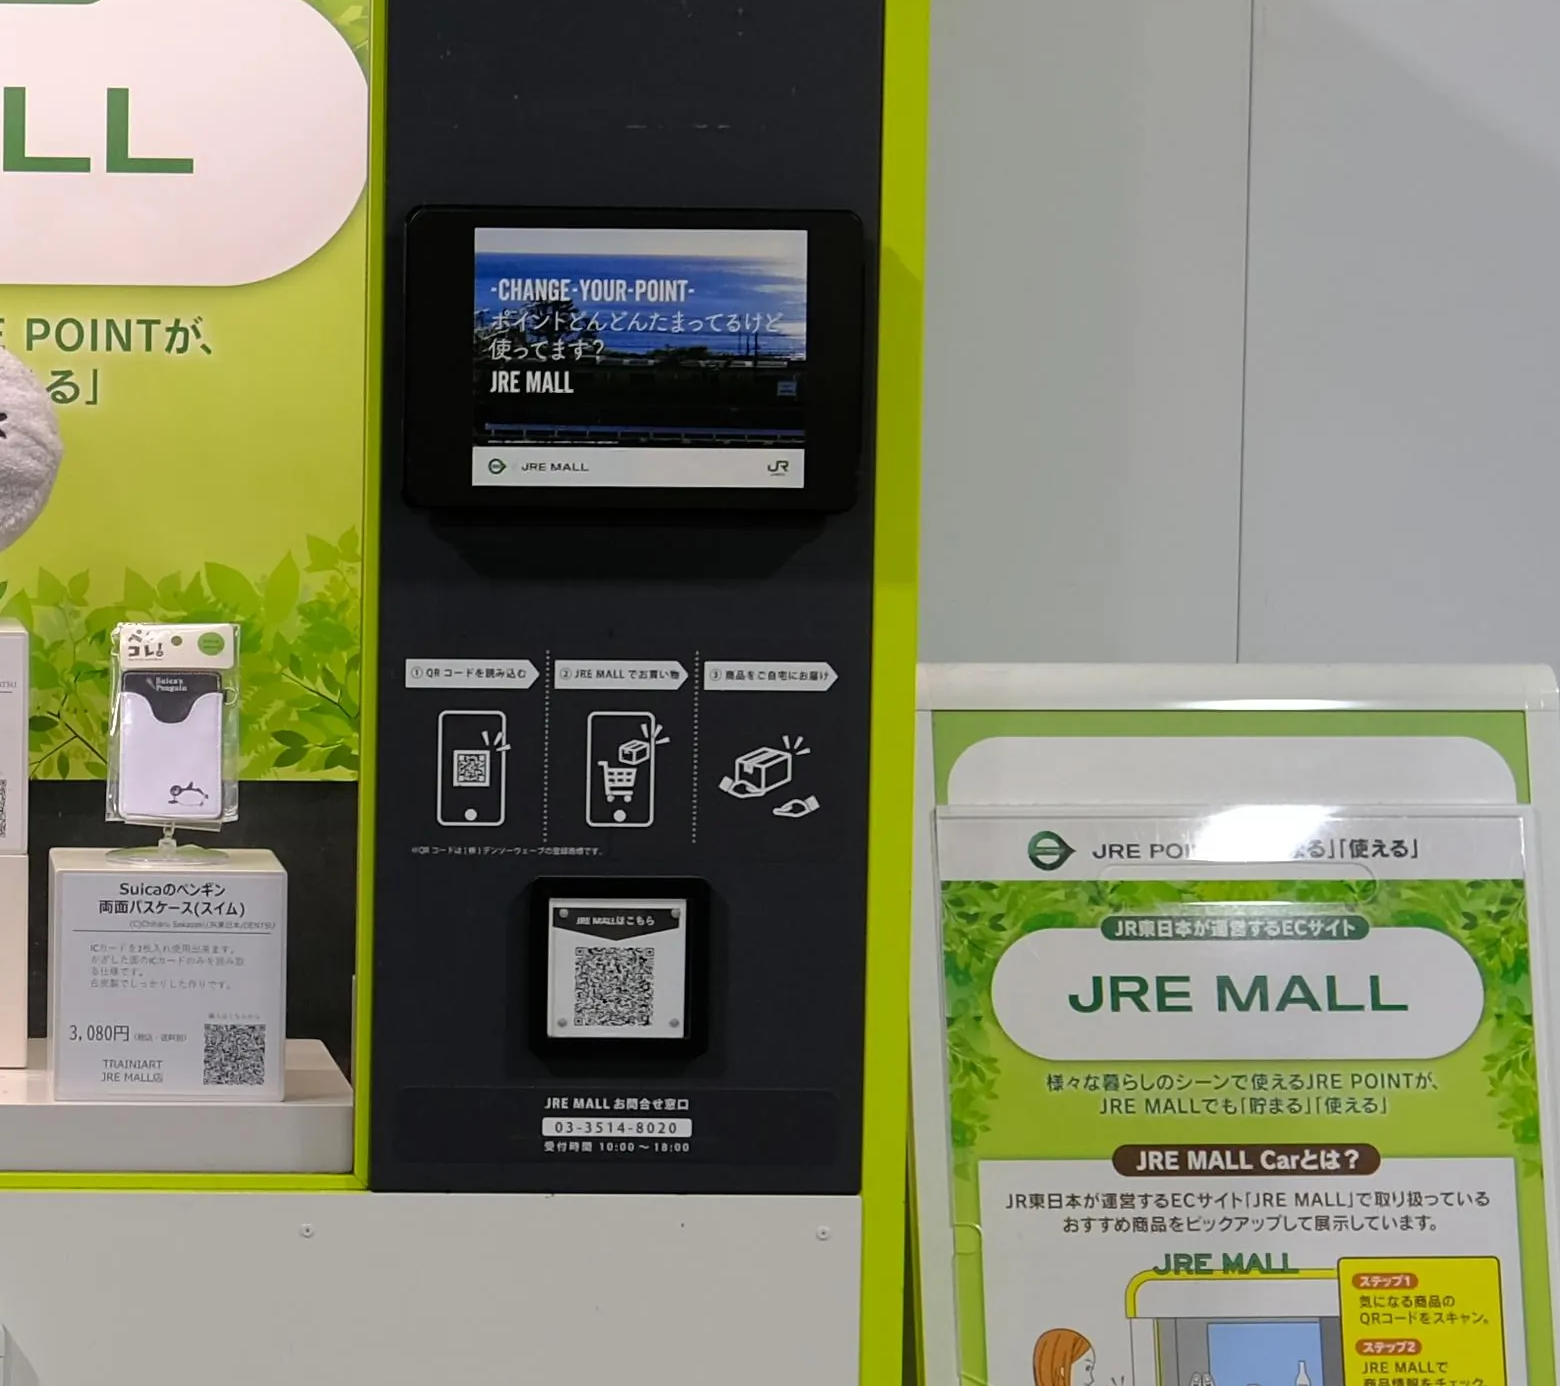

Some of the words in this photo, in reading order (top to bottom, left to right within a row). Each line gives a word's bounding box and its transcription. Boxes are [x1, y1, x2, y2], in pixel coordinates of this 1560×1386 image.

[491, 311, 782, 332] ポイントどんどんたまってるけど
[489, 339, 604, 361] 使ってます？
[490, 371, 520, 393] JRE
[526, 371, 574, 393] MALL
[521, 462, 546, 472] JRE
[551, 462, 589, 472] MALL
[767, 460, 789, 473] JR
[426, 668, 440, 678] QR
[574, 669, 592, 679] JRE
[596, 669, 625, 679] MALL
[1092, 844, 1141, 859] JRE
[120, 883, 225, 897] Suicaのペンギン
[99, 900, 245, 917] 両面パスケース(スイム)
[1115, 920, 1355, 937] JR東日本が運営するECサイト
[1068, 975, 1191, 1013] JRE
[1217, 975, 1408, 1012] MALL
[70, 1025, 129, 1041] 3,080円
[103, 1060, 163, 1069] TRAINIART
[102, 1073, 120, 1082] JRE
[544, 1098, 568, 1109] JRE
[573, 1098, 610, 1109] MALL
[614, 1098, 689, 1110] お問合せ窓口
[1100, 1098, 1136, 1114] JRE
[1145, 1097, 1388, 1115] MALLでも「貯まる」「使える」
[555, 1121, 677, 1134] 03-3514-8020
[544, 1141, 592, 1152] 受付時間
[600, 1142, 635, 1152] 10:00
[654, 1143, 689, 1152] 18:00
[1137, 1151, 1180, 1171] JRE
[1188, 1151, 1253, 1171] MALL
[1260, 1150, 1359, 1170] Carとは？
[1063, 1214, 1437, 1234] おすすめ商品をピックアップして展示しています。
[1152, 1253, 1213, 1275] JRE
[1222, 1253, 1299, 1274] MALL
[1360, 1276, 1411, 1287] ステップ1
[1359, 1295, 1455, 1308] 気になる商品の
[1360, 1312, 1489, 1326] QRコードをスキャン。
[1363, 1342, 1416, 1353] ステップ2
[1362, 1362, 1389, 1374] JRE
[1395, 1361, 1448, 1374] MALLで
